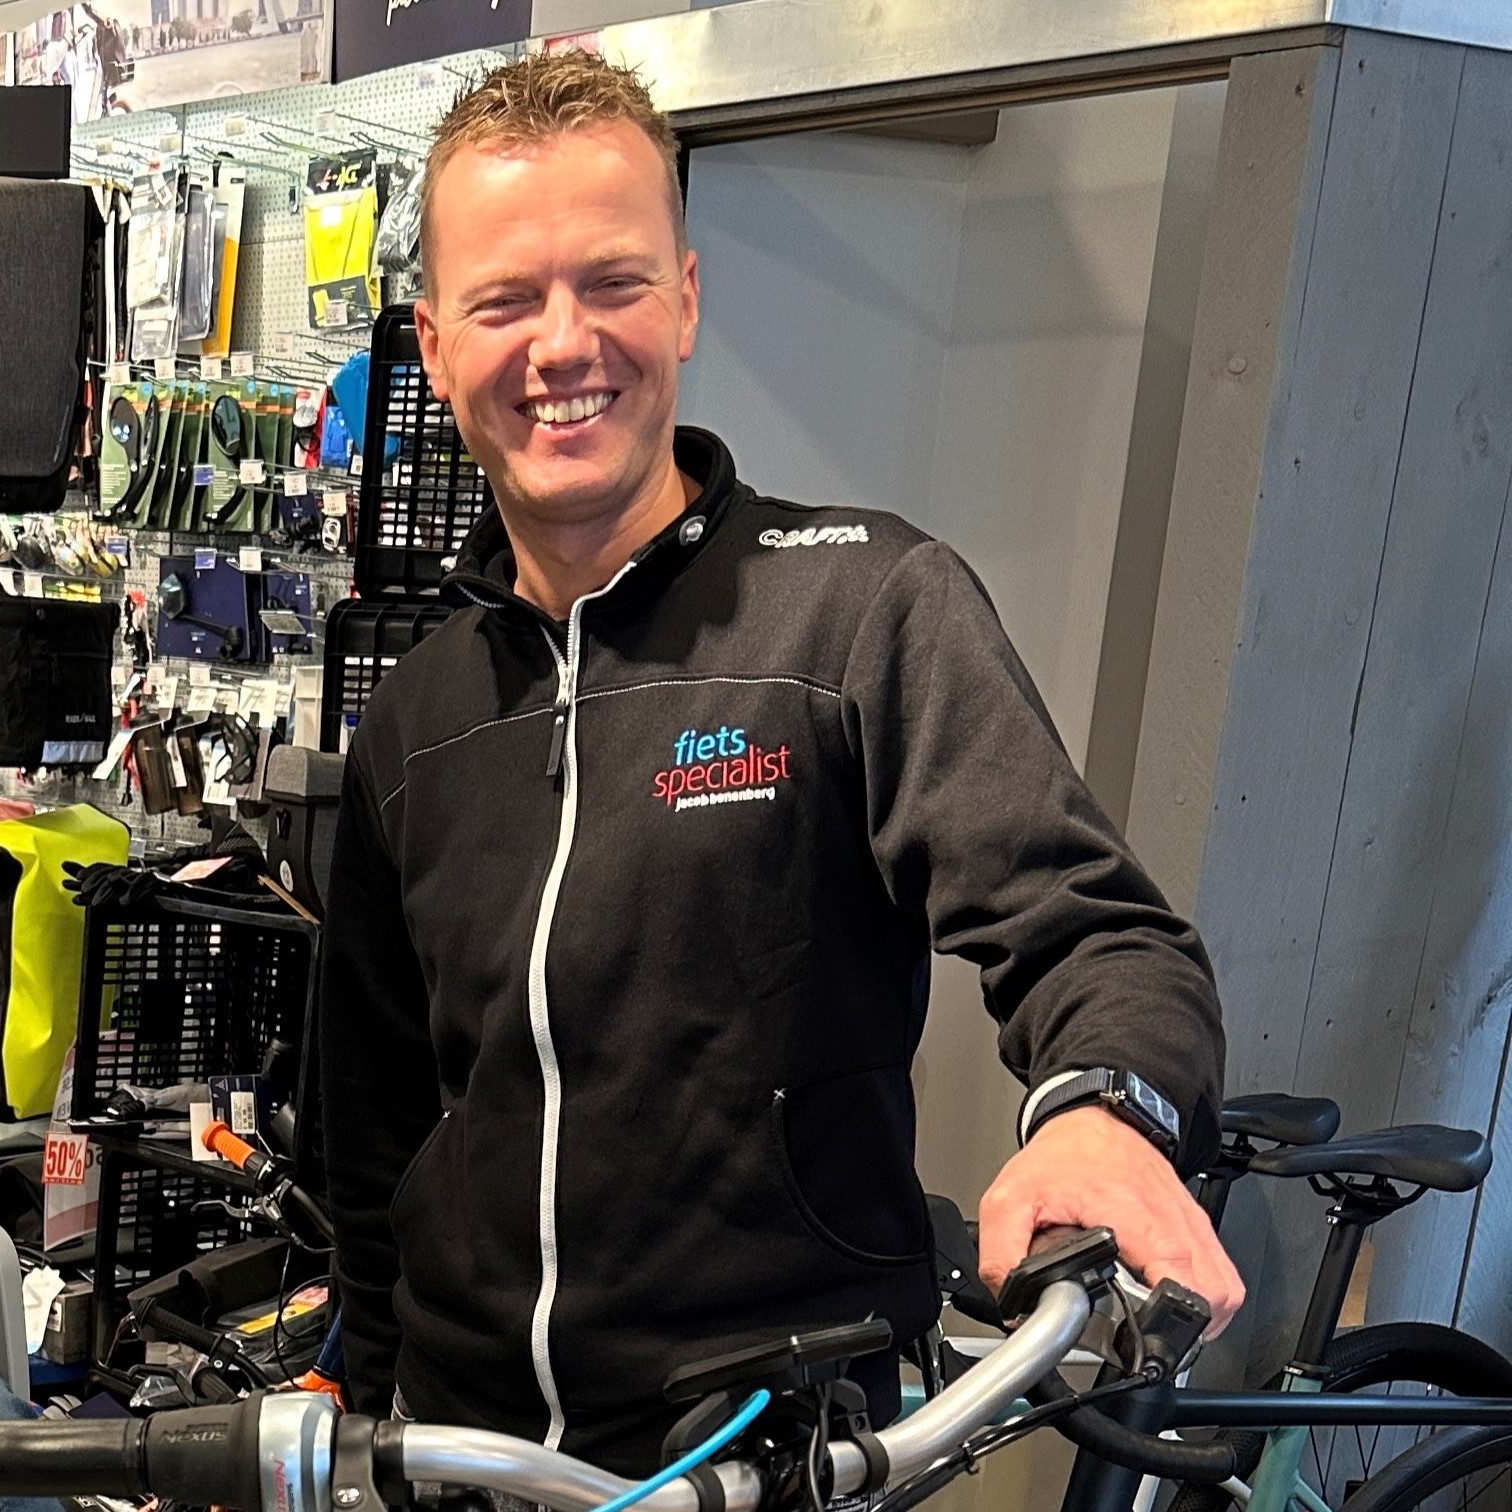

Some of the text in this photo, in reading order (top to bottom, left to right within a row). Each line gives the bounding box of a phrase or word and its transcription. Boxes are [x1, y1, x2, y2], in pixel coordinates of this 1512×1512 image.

[674, 726, 746, 766] fiets
[652, 743, 792, 806] specialist
[46, 1140, 83, 1178] 50%
